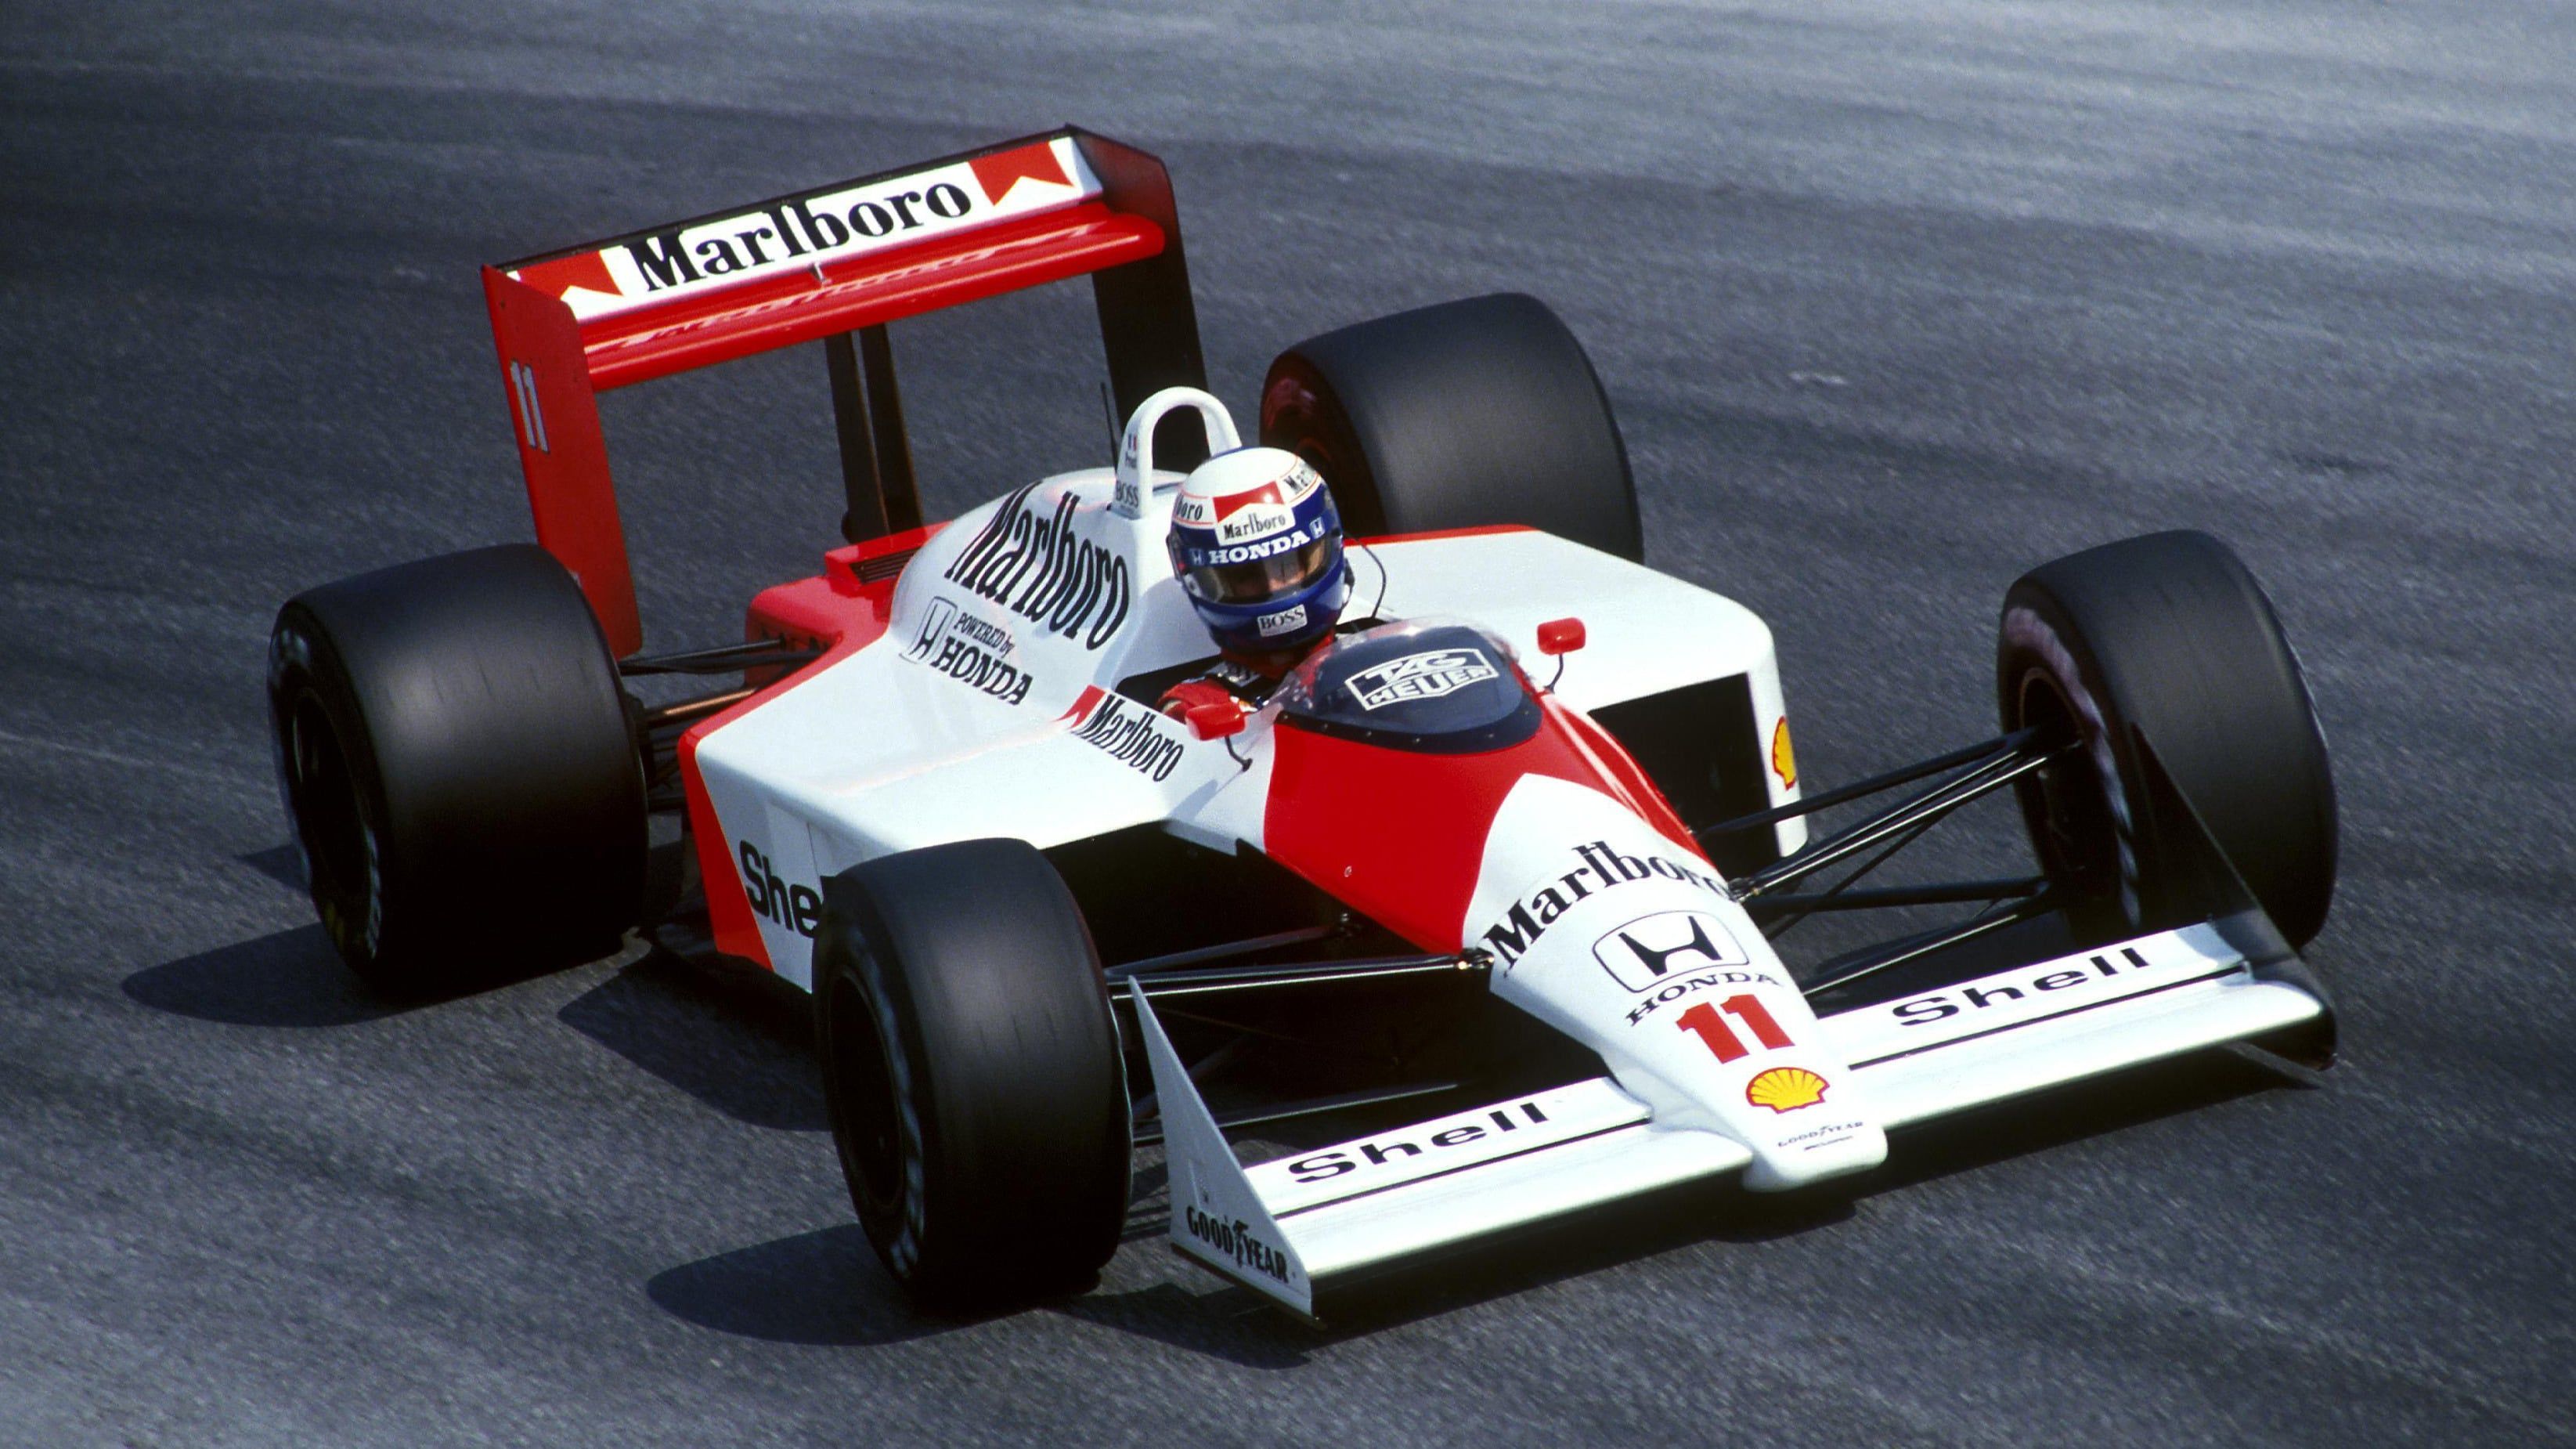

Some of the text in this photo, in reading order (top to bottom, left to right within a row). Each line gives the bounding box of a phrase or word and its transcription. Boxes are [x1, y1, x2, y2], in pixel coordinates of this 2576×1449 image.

[621, 182, 972, 292] Marlboro
[510, 359, 549, 453] 11
[1116, 479, 1139, 508] BOSS
[1176, 493, 1203, 521] boro
[1224, 513, 1286, 540] Marlboro
[944, 481, 1129, 650] Marlboro
[1208, 529, 1311, 564] HONDA
[954, 612, 1016, 659] POWERED by
[1259, 609, 1304, 630] BOSS
[929, 635, 1033, 706] HONDA
[1365, 653, 1467, 681] TAG
[1370, 669, 1492, 704] HEUER
[1070, 693, 1183, 782] Marlboro
[740, 840, 822, 939] She
[1483, 840, 1737, 977] Marlboro
[1625, 972, 1780, 1027] HONDA
[1892, 947, 2150, 1027] Shell
[1675, 994, 1795, 1064] 11
[1288, 1101, 1550, 1183] Shell
